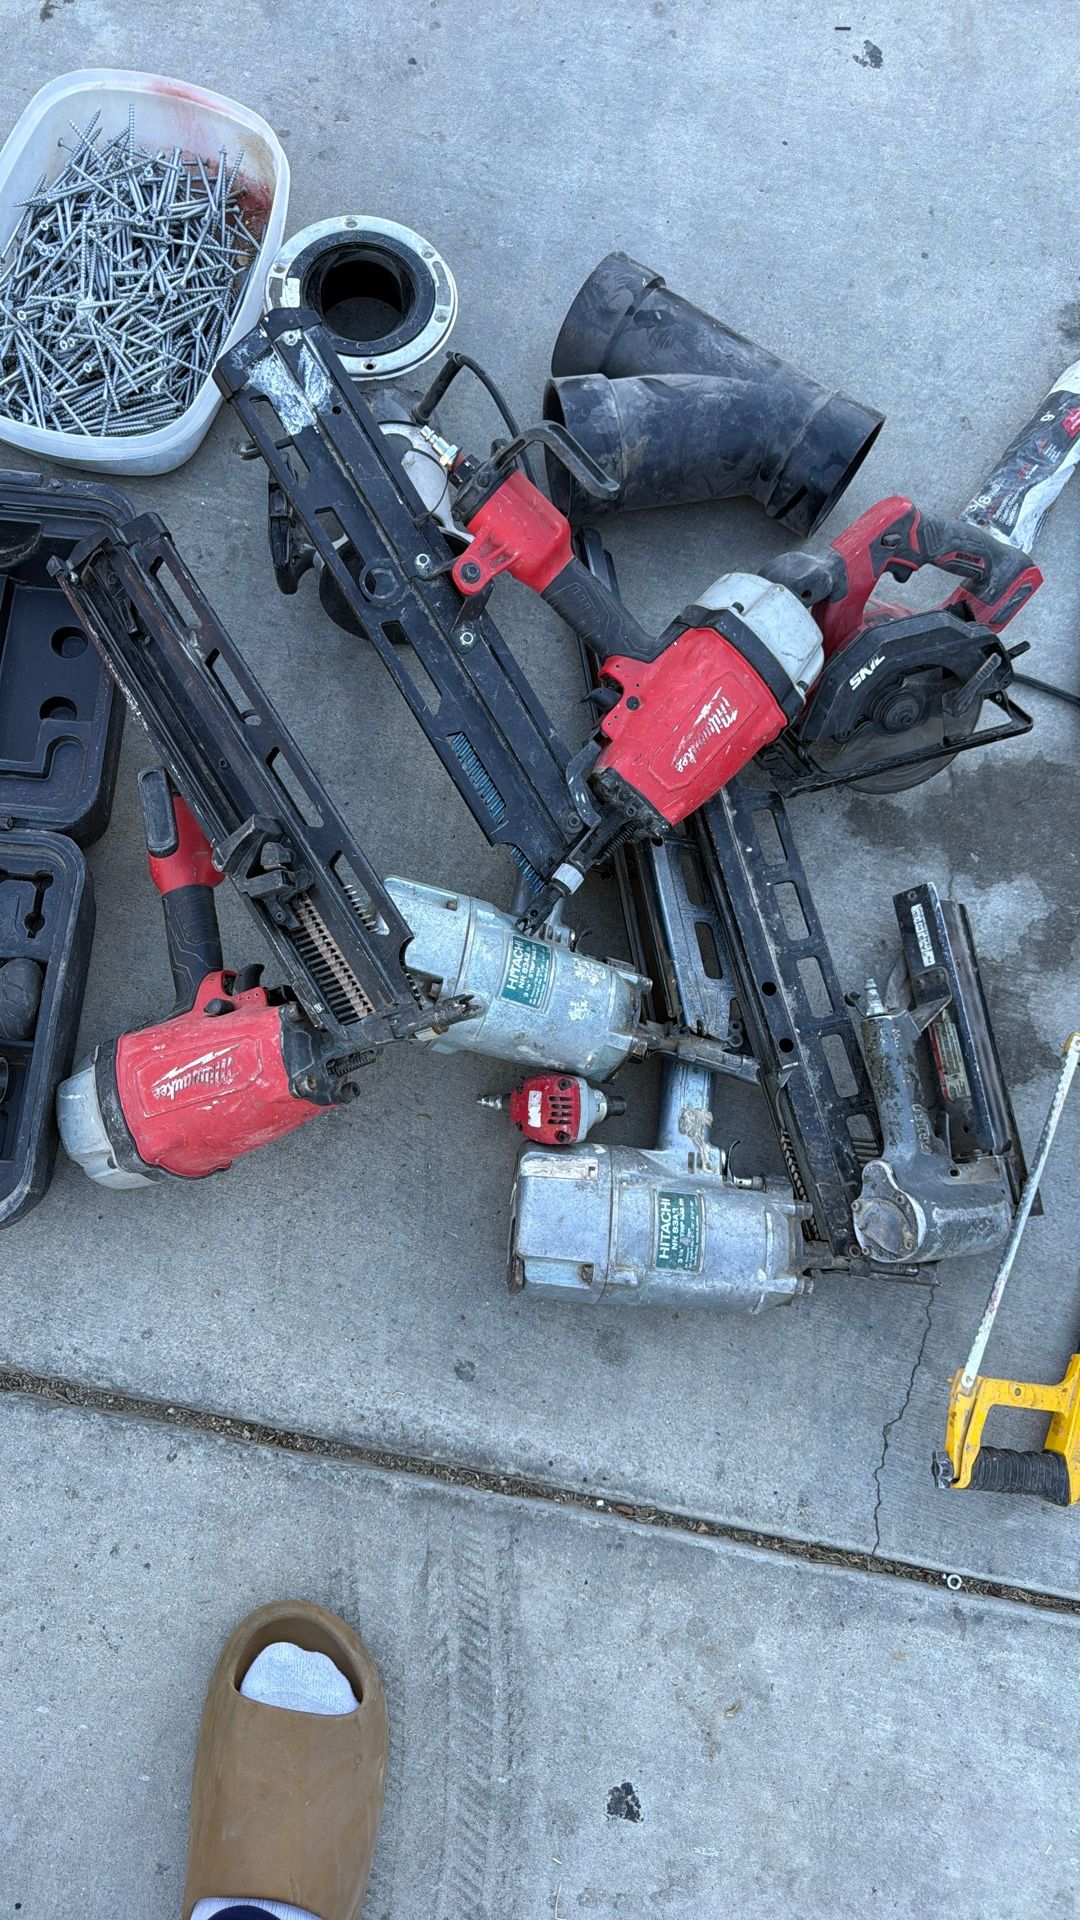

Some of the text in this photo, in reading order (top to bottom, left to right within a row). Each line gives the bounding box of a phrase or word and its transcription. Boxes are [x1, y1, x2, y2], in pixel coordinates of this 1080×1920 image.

[849, 654, 886, 690] SKIL
[675, 696, 738, 772] Milwaukee
[506, 940, 524, 990] HITACHI
[518, 976, 527, 989] NR
[153, 1055, 239, 1100] Milwaukee
[659, 1198, 672, 1259] HITACHI
[671, 1235, 679, 1250] NR
